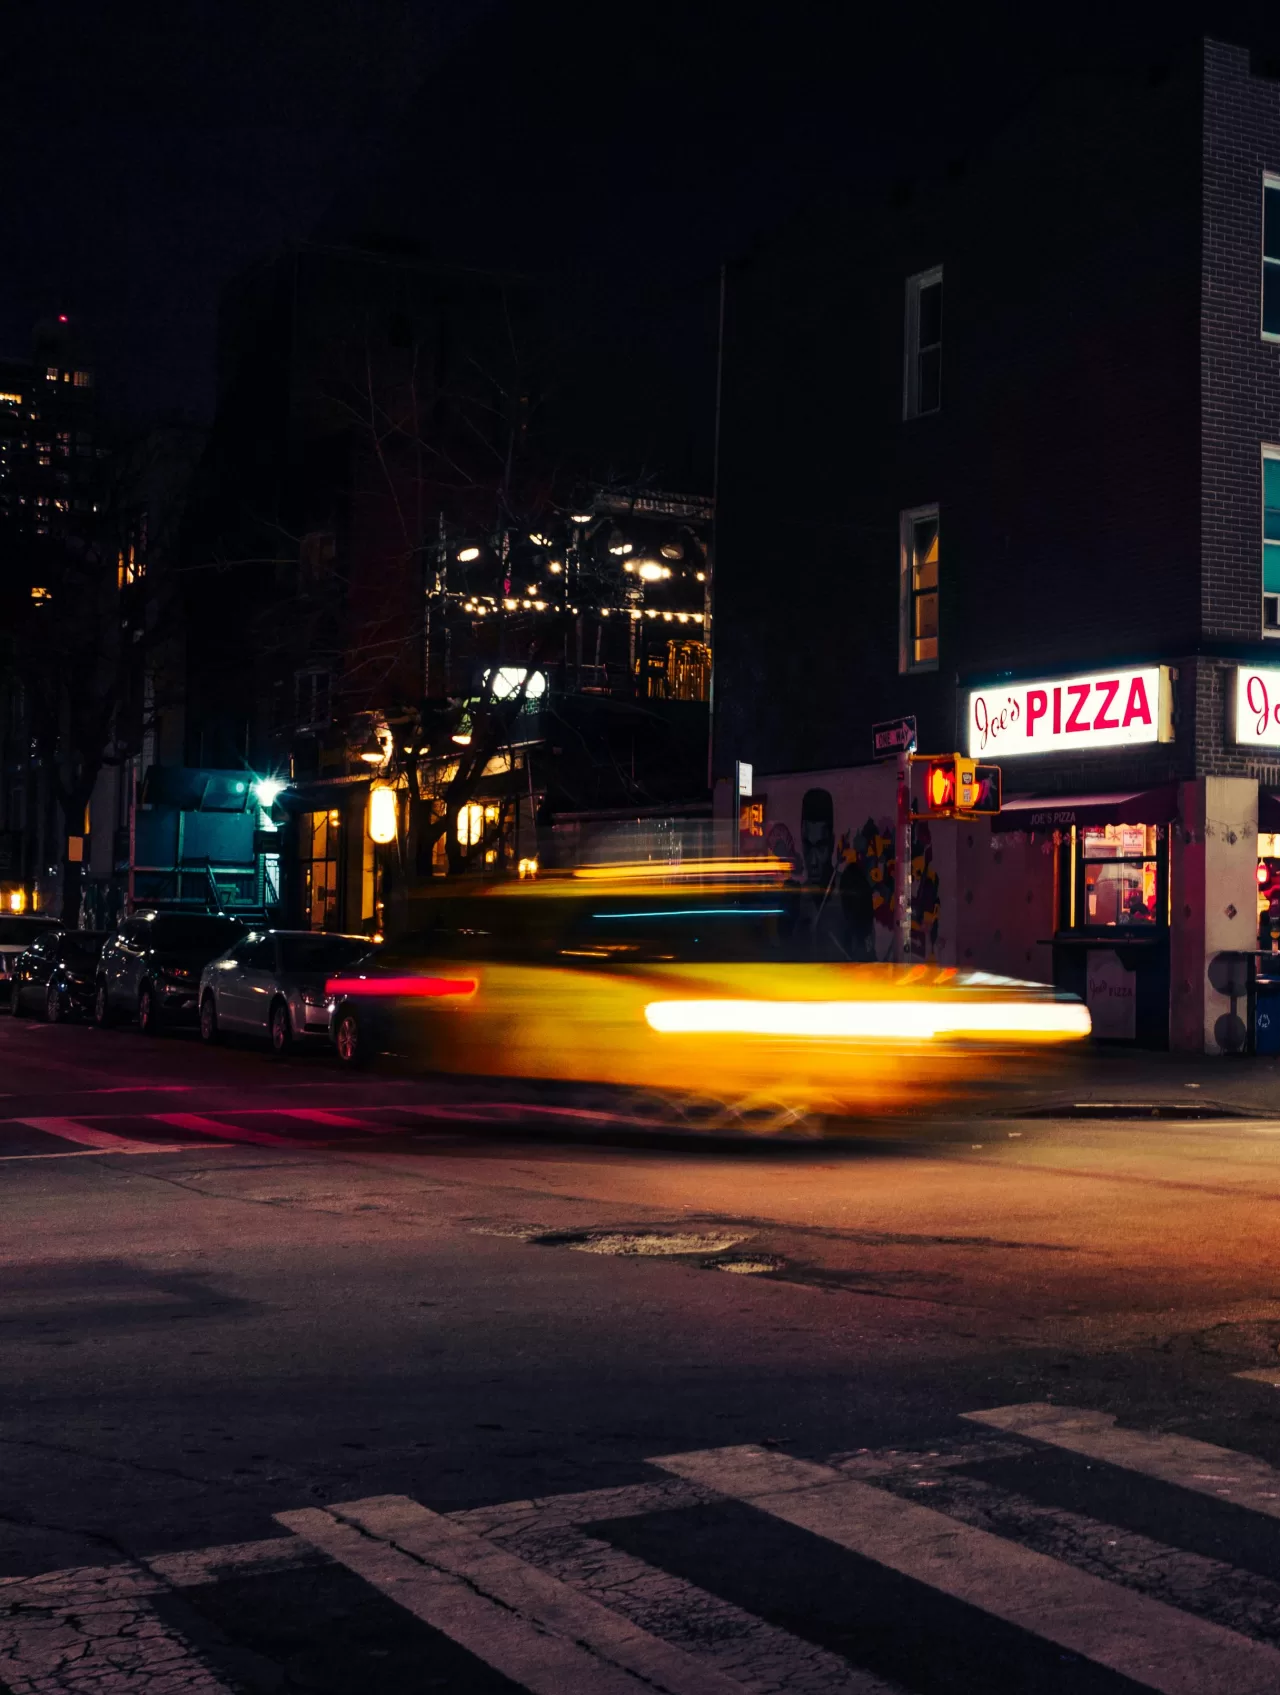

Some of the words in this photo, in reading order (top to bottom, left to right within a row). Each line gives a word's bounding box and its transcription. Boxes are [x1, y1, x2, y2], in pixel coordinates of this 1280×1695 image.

[975, 697, 1020, 750] Joe's
[1026, 677, 1152, 737] PIZZA
[878, 733, 891, 748] ONE
[896, 728, 909, 744] WAY
[1054, 812, 1076, 824] PIZZA
[1109, 987, 1133, 997] PIZZA
